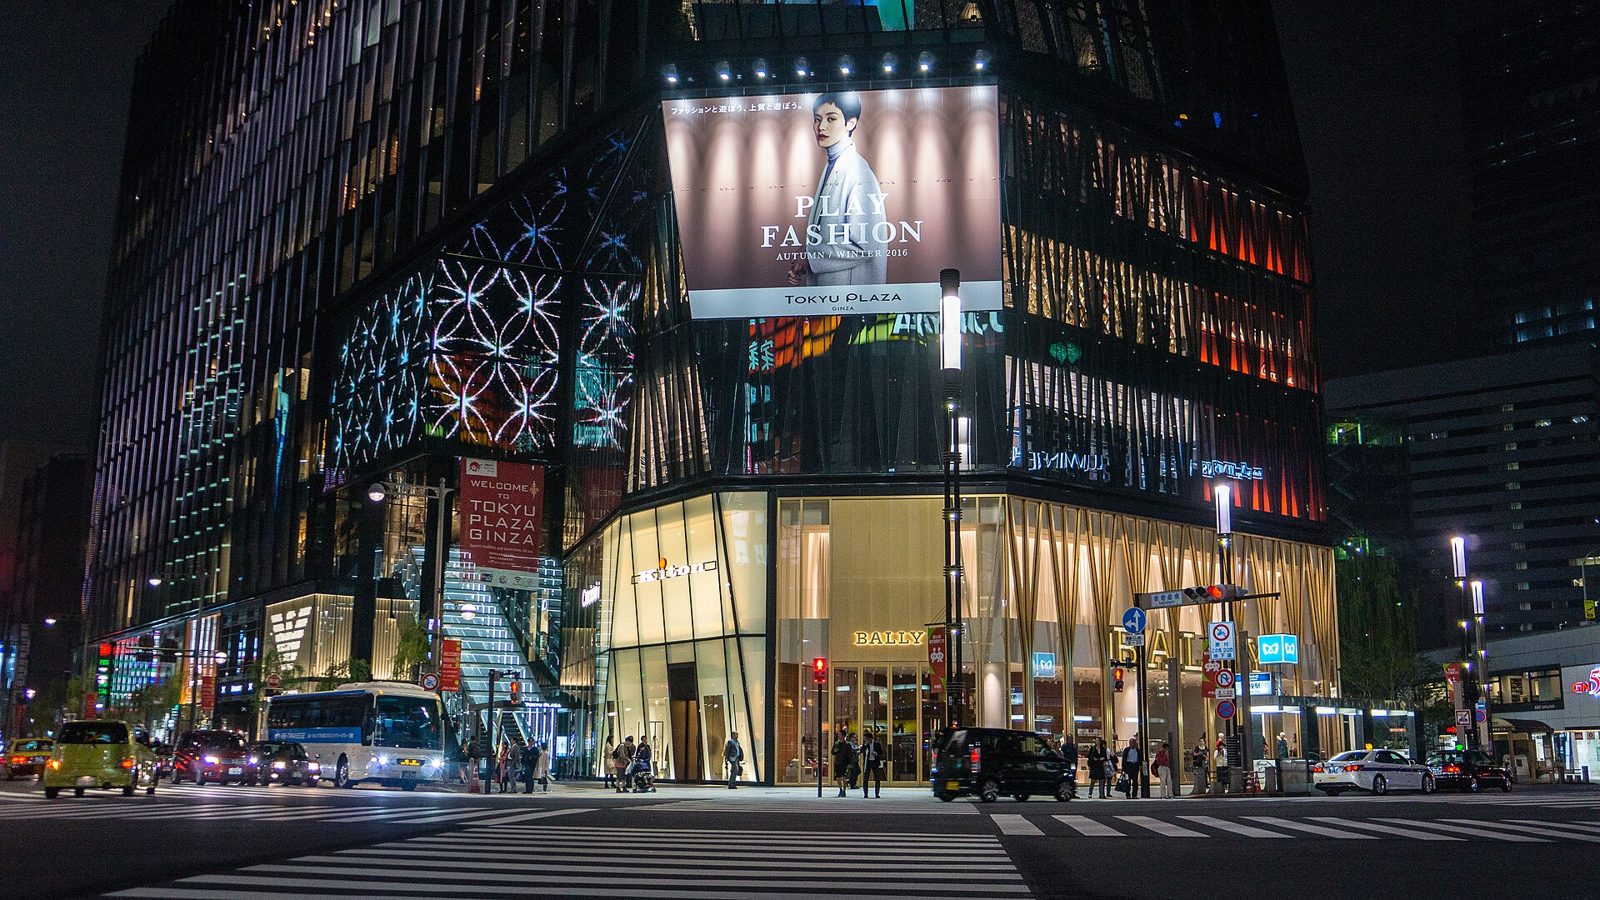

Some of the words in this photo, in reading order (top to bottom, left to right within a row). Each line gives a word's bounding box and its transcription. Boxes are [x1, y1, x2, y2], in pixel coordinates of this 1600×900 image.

[671, 101, 802, 115] ファッションと遊ぼう、上質と遊ぼう。
[794, 192, 889, 218] PLAY
[760, 220, 923, 248] FASHION
[776, 251, 825, 261] AUTUMN
[835, 249, 882, 259] WINTER
[886, 248, 908, 257] 2016
[470, 479, 529, 493] WELCOME
[470, 499, 536, 517] TOKYU
[469, 514, 535, 532] PLAZA
[469, 528, 535, 546] GINZA
[855, 631, 924, 645] BALLY
